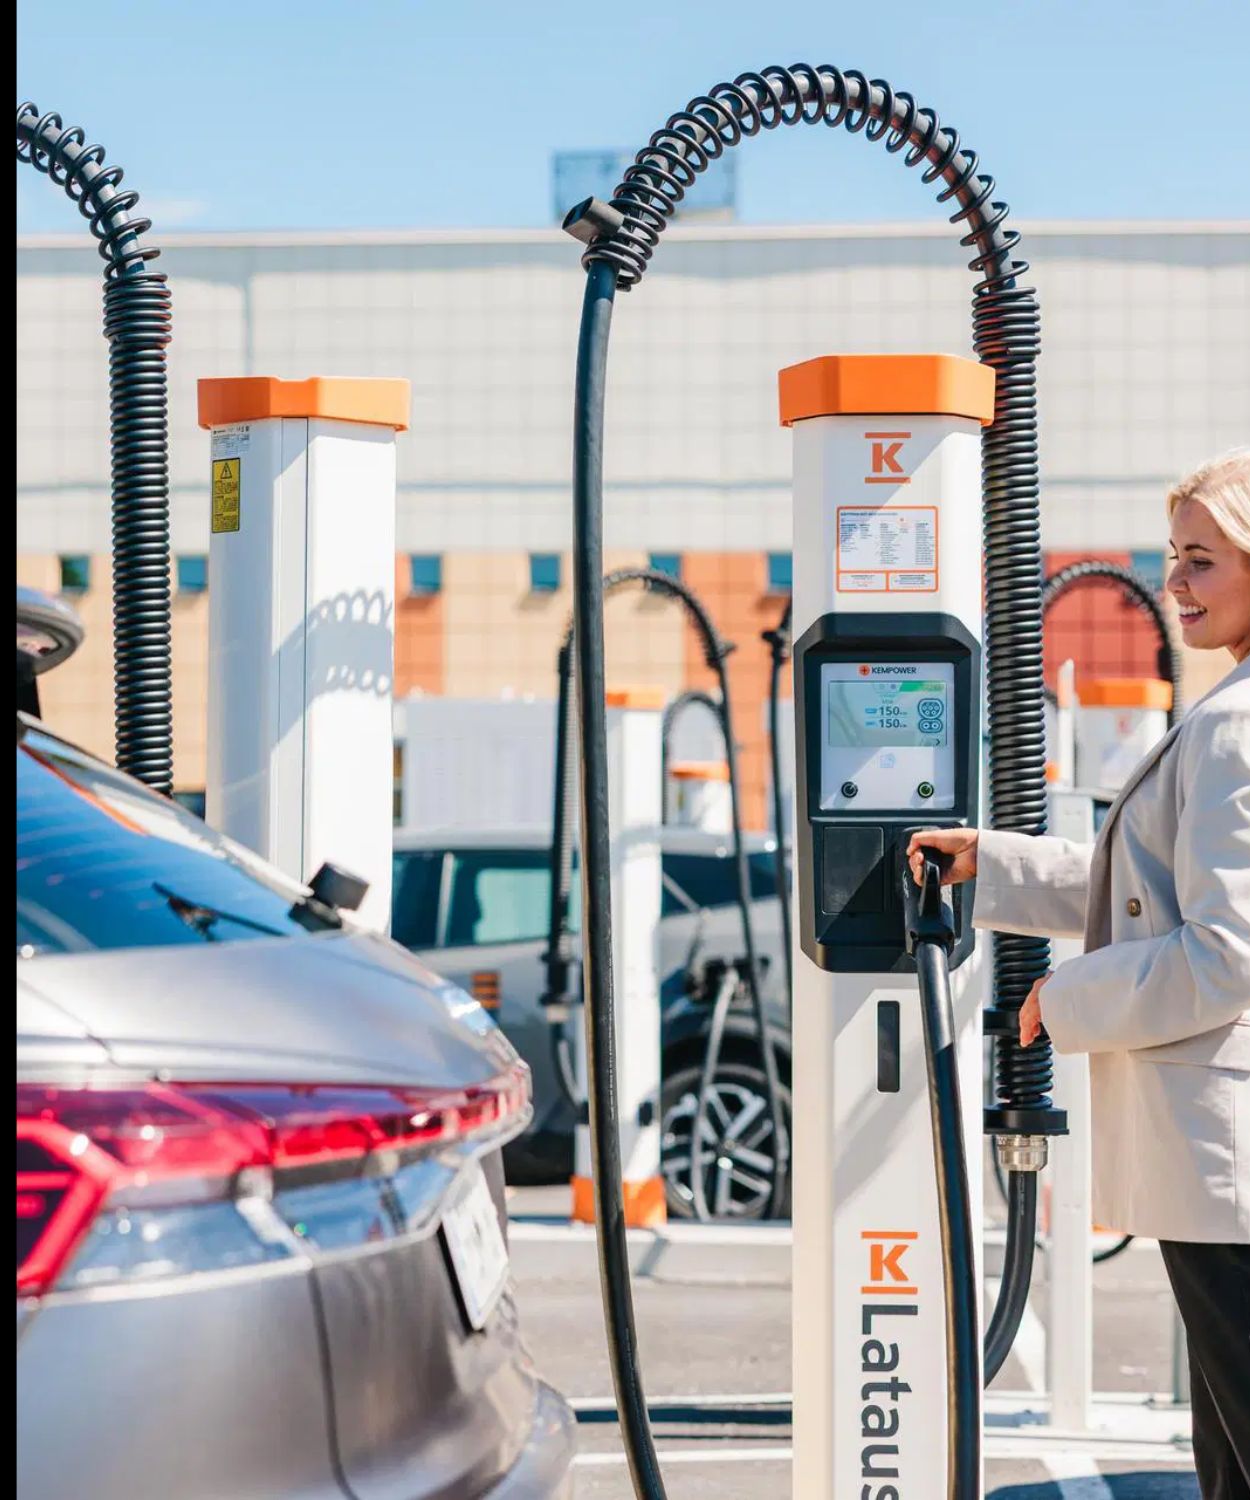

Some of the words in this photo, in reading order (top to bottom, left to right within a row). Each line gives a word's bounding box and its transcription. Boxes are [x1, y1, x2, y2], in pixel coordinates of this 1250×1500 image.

[871, 666, 917, 674] KEMPOWER
[879, 706, 900, 716] 150
[879, 718, 900, 728] 150
[861, 1304, 919, 1500] Lataus
